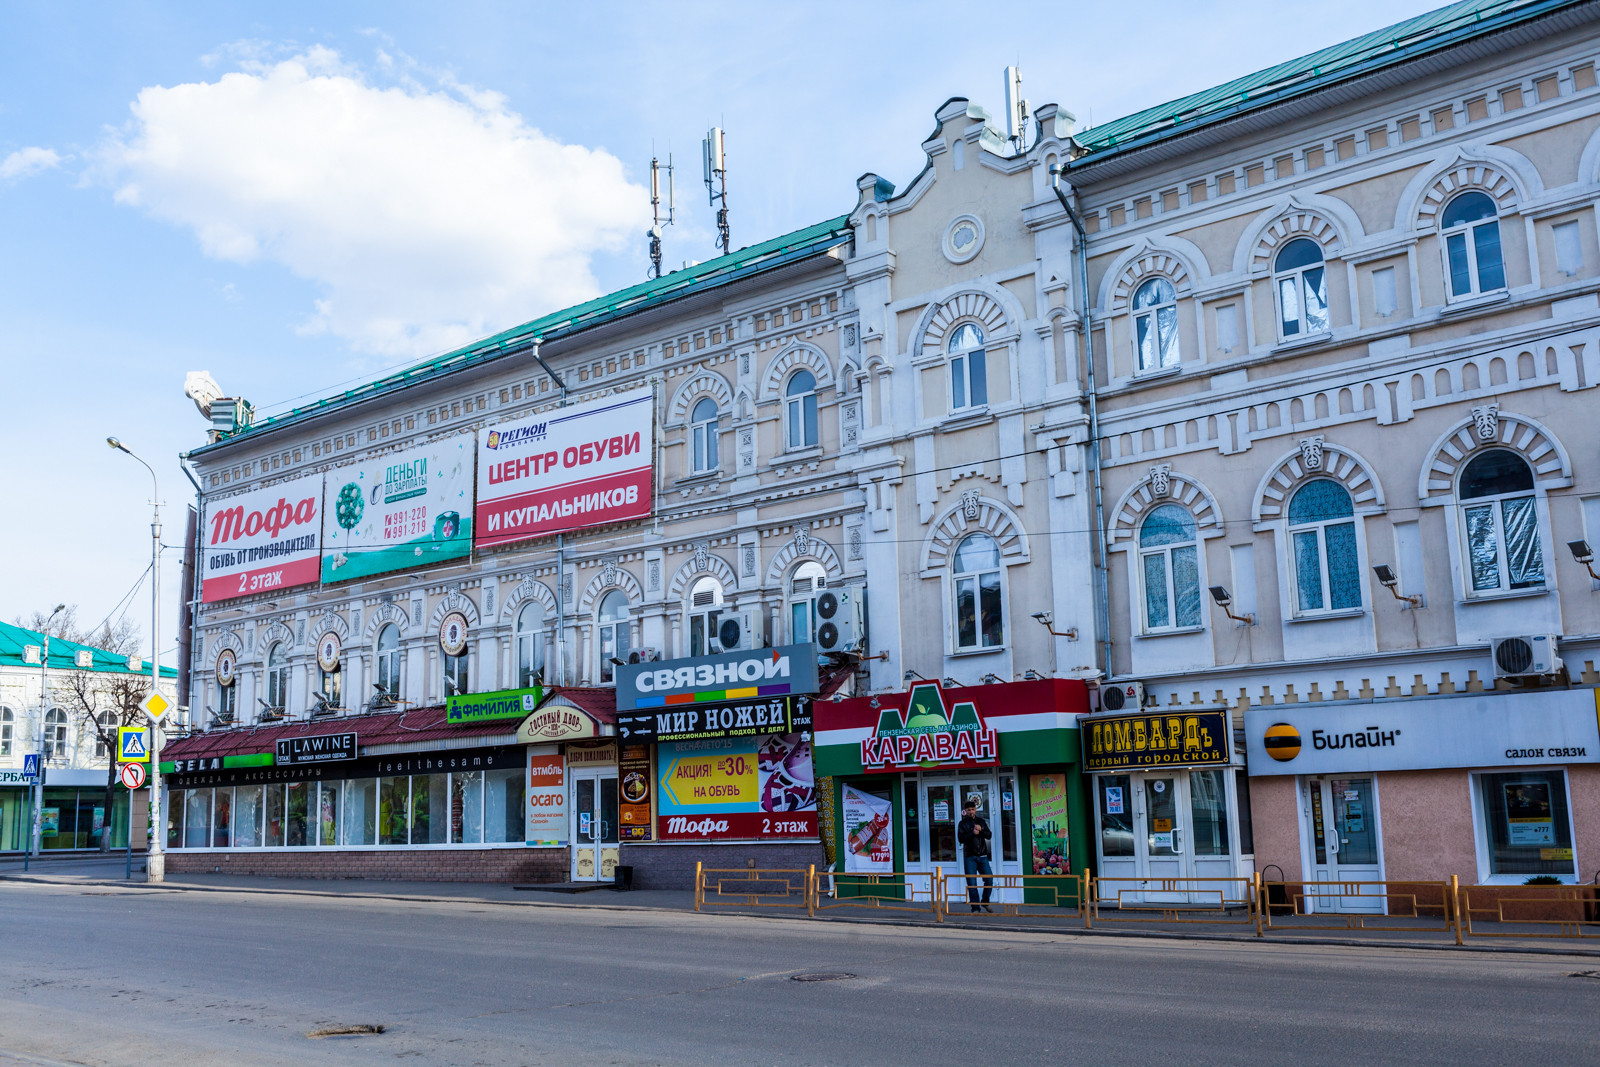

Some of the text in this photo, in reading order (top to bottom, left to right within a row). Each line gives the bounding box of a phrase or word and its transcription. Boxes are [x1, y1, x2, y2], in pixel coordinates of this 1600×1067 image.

[501, 422, 547, 443] РЕГИОН
[489, 432, 640, 485] ЦЕНТР ОБУВИ
[386, 458, 427, 484] ДЕНЬГИ
[385, 476, 428, 495] ДО ЗАРПЛАТЫ
[393, 506, 426, 525] 991-220
[488, 485, 638, 532] И КУПАЛЬНИКОВ
[392, 520, 426, 539] 991-219
[210, 534, 316, 570] ОБУВЬ ОТ ПРОИЗВОДИТЕЛЯ
[238, 570, 283, 592] 2 этаж
[636, 651, 790, 692] СВЯЗНОЙ
[463, 700, 520, 717] ФАМИЛИЯ
[526, 696, 530, 704] 4
[656, 700, 784, 734] МИР НОЖЕЙ
[797, 704, 804, 715] 1
[530, 710, 580, 732] ГОСТИНЫЙ ДВОР
[792, 716, 811, 726] ЭТАЖ
[880, 727, 920, 737] ПЕНЗЕНСКАЯ
[939, 723, 978, 732] МАГАЗИНОВ
[658, 730, 725, 742] ПРОФЕССИОНАЛЬНЫЙ
[730, 728, 756, 736] ПОДХОД
[768, 725, 786, 734] ДЕЛУ
[1092, 716, 1213, 754] ЛОМБАРДЪ
[280, 742, 285, 754] 1
[861, 728, 998, 766] КАРАВАН
[1506, 746, 1586, 759] салон связи
[174, 758, 220, 772] SELA
[1090, 750, 1220, 768] первый городской
[178, 774, 222, 786] ОДЕЖДА
[245, 768, 322, 781] АКСЕССУАРЫ
[532, 764, 562, 776] втмбль
[676, 764, 712, 780] АКЦИЯ!
[694, 784, 740, 797] НА ОБУВЬ
[531, 794, 563, 807] осаго
[762, 819, 808, 834] 2 этаж
